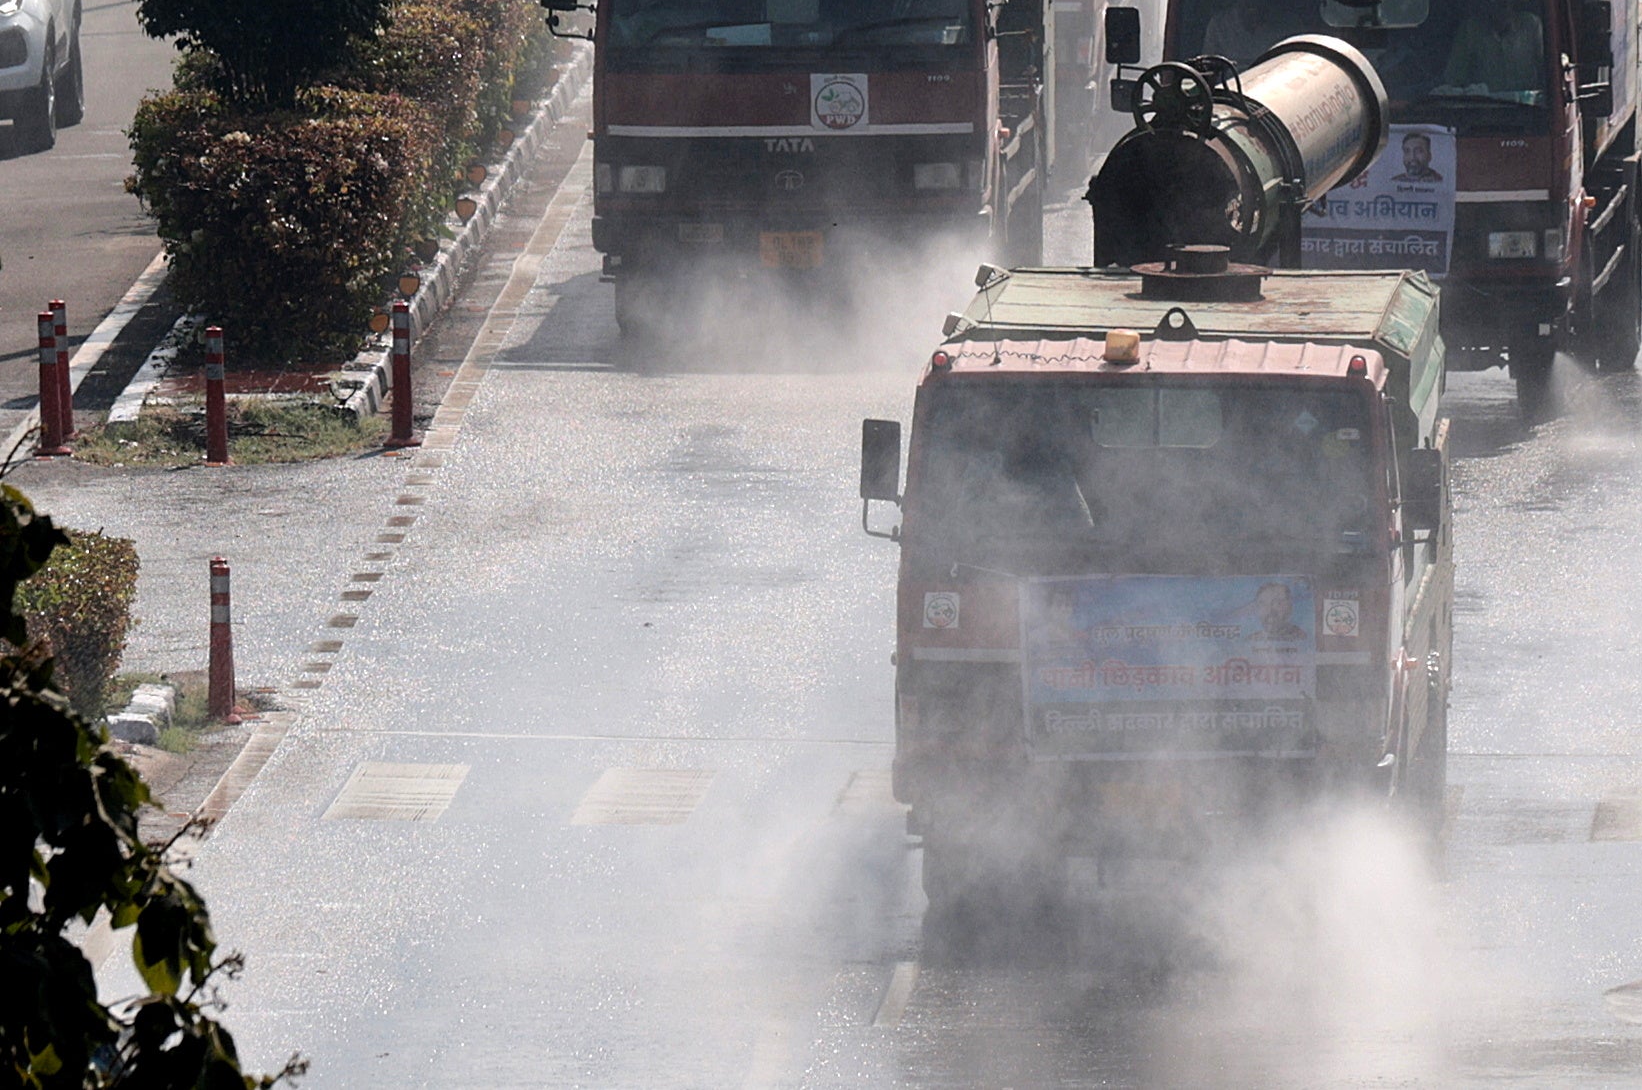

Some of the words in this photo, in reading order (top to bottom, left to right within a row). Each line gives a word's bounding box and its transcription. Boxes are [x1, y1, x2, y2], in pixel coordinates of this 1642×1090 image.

[763, 138, 815, 153] TATA
[1354, 194, 1438, 219] अभियान
[1334, 237, 1364, 258] द्वारा
[1368, 234, 1439, 256] संचालित
[1204, 657, 1303, 687] अभियान
